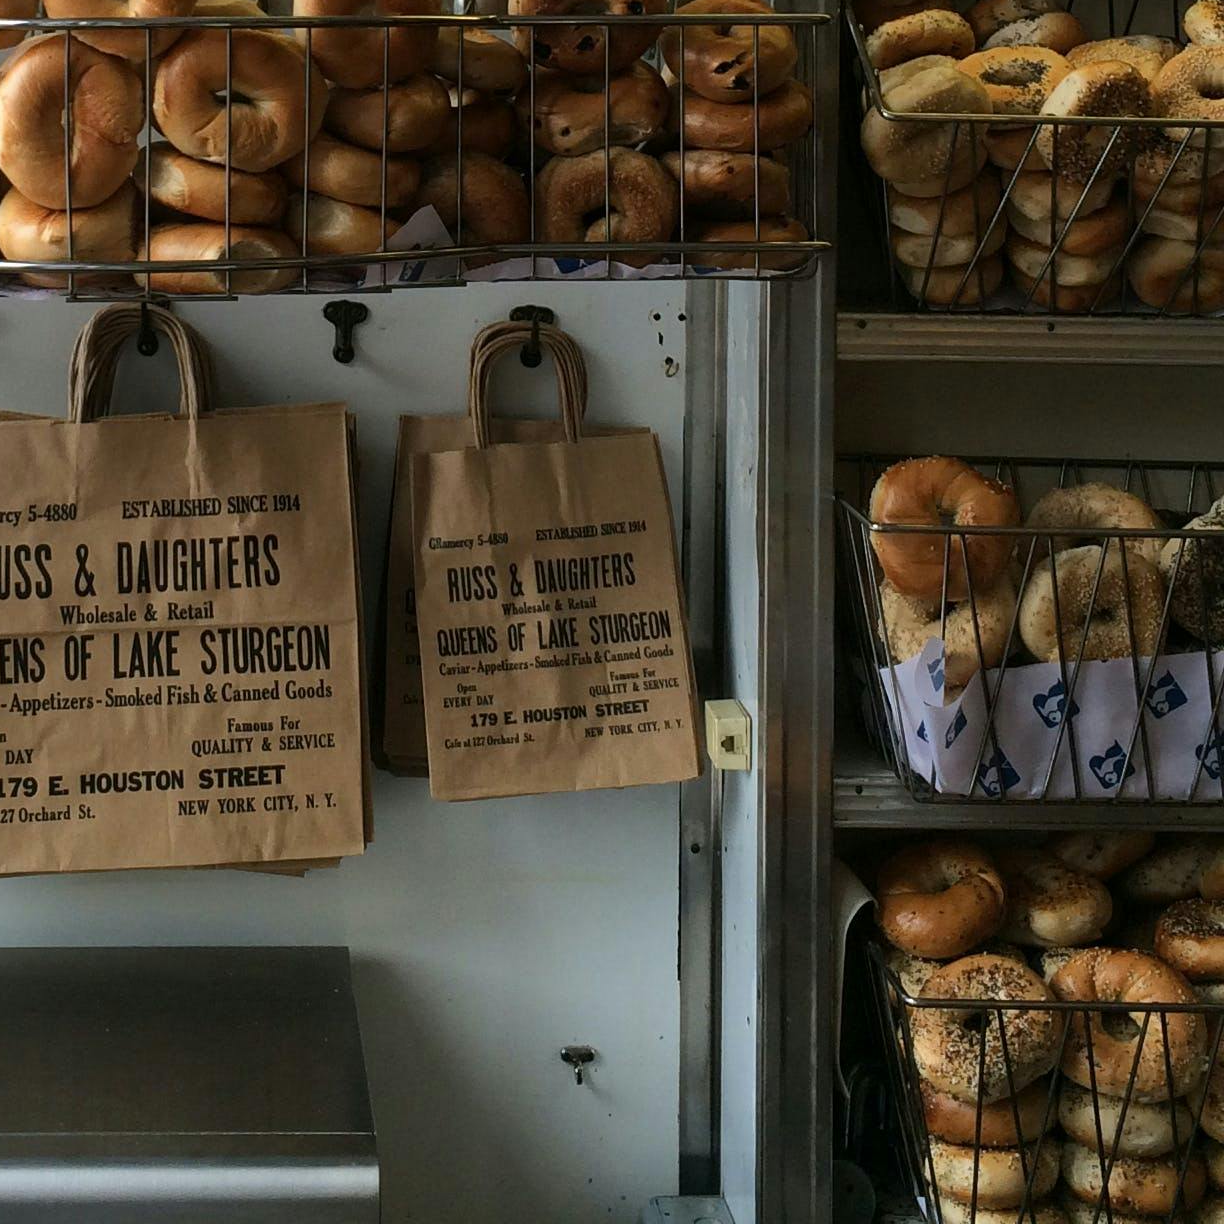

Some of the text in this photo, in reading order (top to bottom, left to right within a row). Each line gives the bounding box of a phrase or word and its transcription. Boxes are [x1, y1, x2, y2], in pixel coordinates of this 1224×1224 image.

[28, 503, 77, 521] 5-4880
[122, 494, 301, 519] ESTABLISHED SINCE 1914
[536, 520, 647, 541] ESTABLISHED SINCE 1914
[74, 544, 96, 597] &
[117, 533, 281, 594] DAUGHTERS
[447, 566, 498, 603] RUSS
[509, 563, 525, 597] &
[534, 552, 636, 594] DAUGHTERS
[59, 600, 214, 625] Wholesale & Retail
[502, 596, 597, 616] Wholesale & Retail
[437, 610, 672, 657] QUEENS OF LAKE STURGEON
[64, 634, 95, 681] OF
[113, 631, 180, 679] LAKE
[200, 625, 331, 675] STURGEON
[572, 651, 592, 666] Fish
[594, 650, 602, 664] &
[603, 647, 641, 663] Canned
[644, 644, 674, 658] Goods
[105, 685, 162, 708] Smoked
[166, 683, 200, 706] Fish
[203, 683, 218, 703] &
[221, 680, 280, 702] Canned
[285, 678, 332, 700] Goods
[457, 683, 477, 694] Open
[589, 677, 679, 697] QUALITY & SERVICE
[443, 695, 494, 708] EVERY DAY
[227, 716, 301, 733] Famous For
[470, 699, 649, 728] 179 E. HOUSTON STREET
[472, 736, 485, 747] 127
[487, 733, 519, 746] Orchard
[585, 727, 604, 738] NEW
[609, 723, 633, 736] YORK
[638, 721, 661, 733] CITY,
[191, 733, 336, 757] QUALITY & SERVICE
[5, 748, 34, 765] DAY
[48, 775, 69, 796] E.
[80, 769, 184, 794] HOUSTON
[198, 764, 286, 789] STREET
[18, 805, 71, 823] Orchard
[78, 804, 96, 820] St.
[178, 799, 209, 816] NEW
[217, 797, 256, 814] YORK
[263, 794, 299, 812] CITY,
